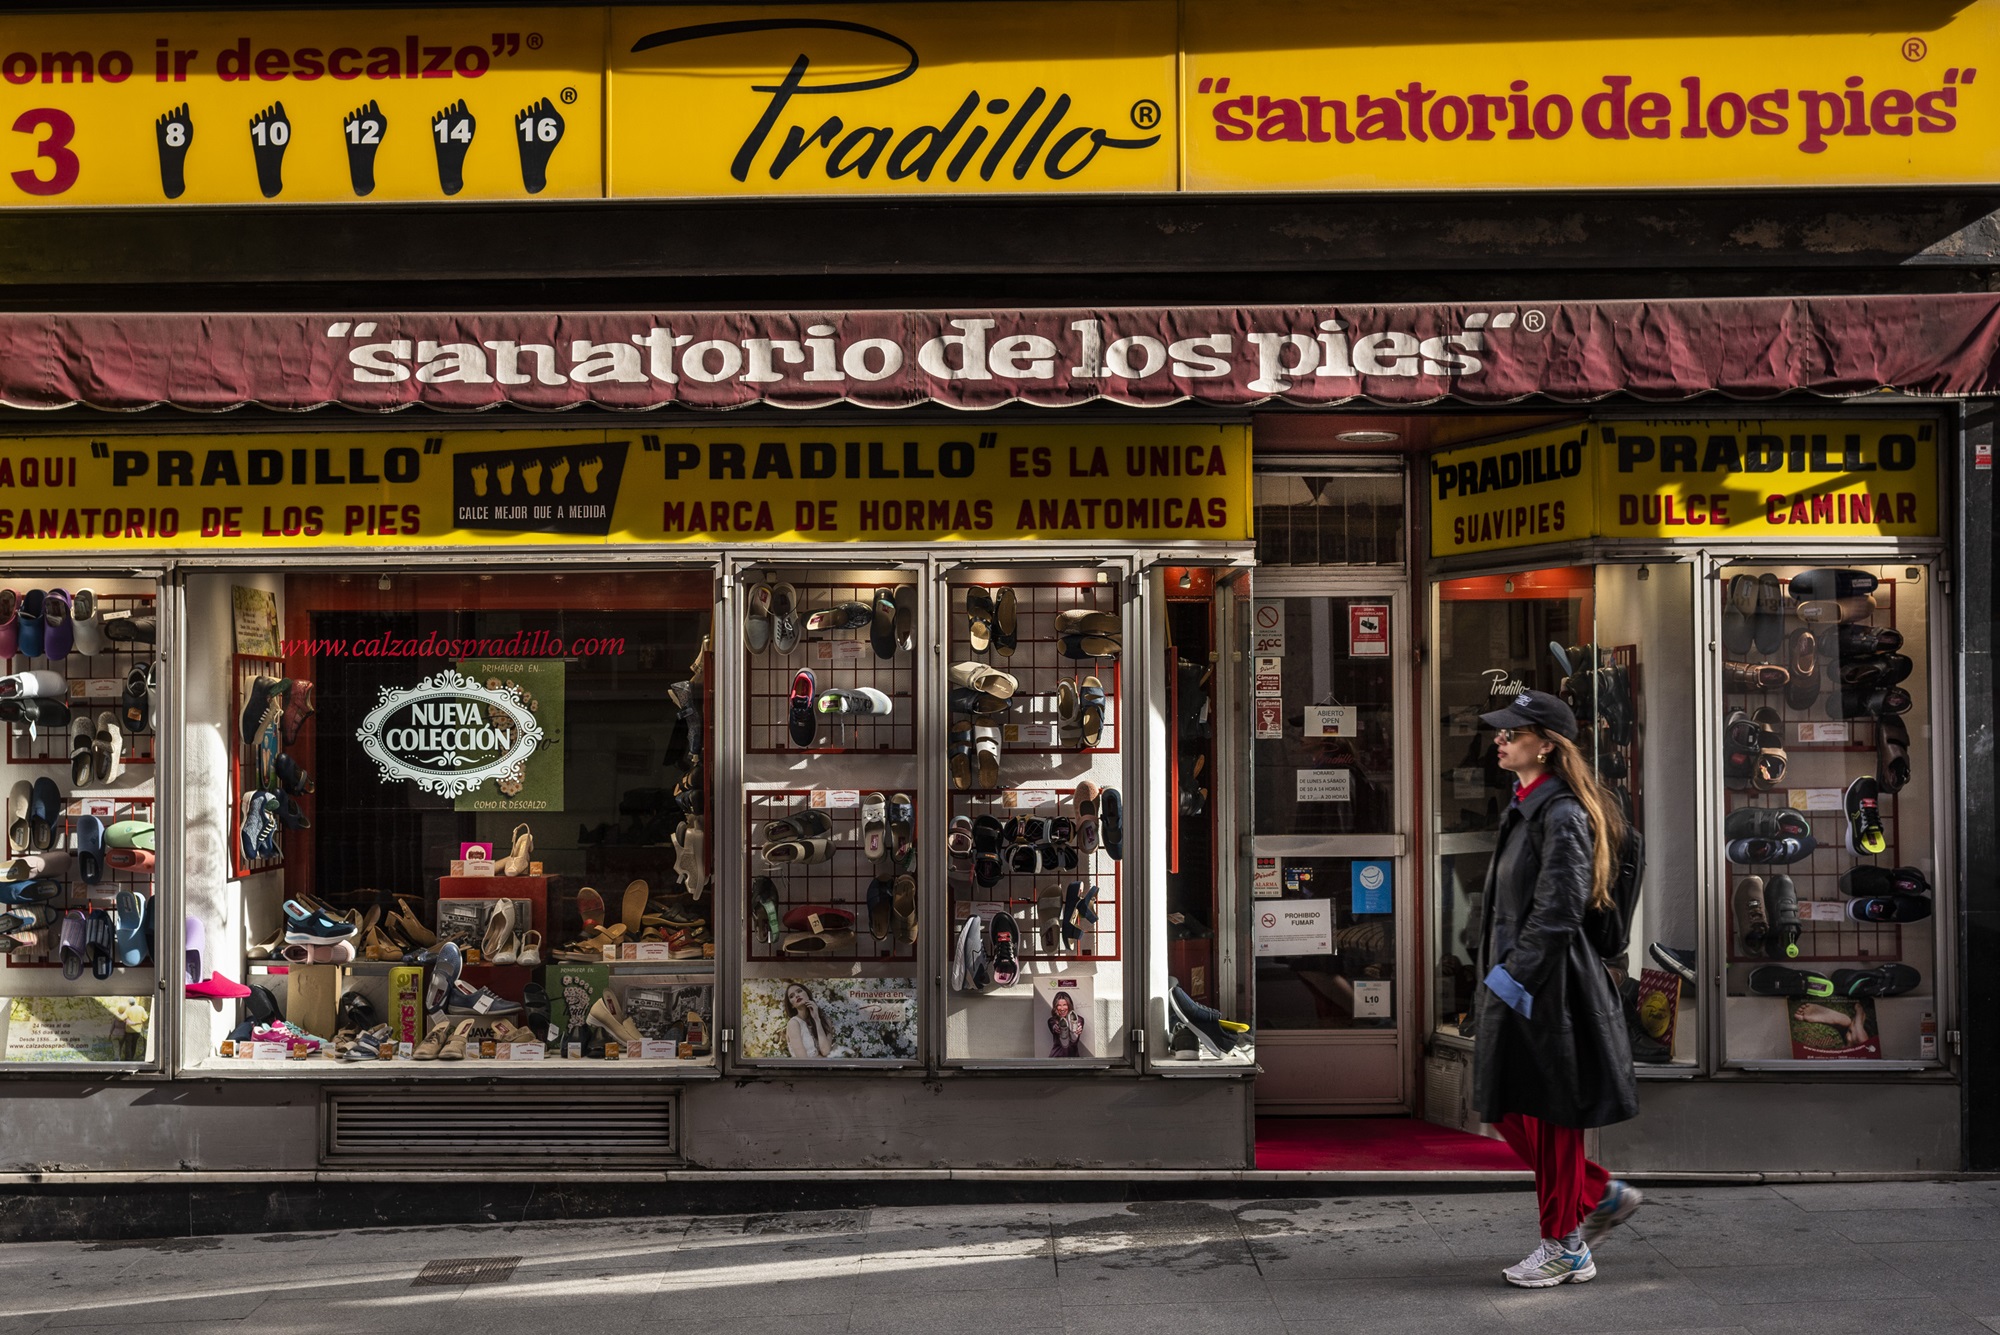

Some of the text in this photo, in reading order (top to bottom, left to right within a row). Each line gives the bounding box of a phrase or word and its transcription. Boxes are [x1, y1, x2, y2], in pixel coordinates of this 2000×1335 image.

[155, 38, 199, 82] ir
[631, 18, 1161, 183] Pradillo
[1581, 75, 1671, 139] de
[1681, 76, 1789, 138] los
[165, 117, 557, 146] 8 10 12 14 16
[10, 107, 80, 196] 3
[918, 318, 1057, 381] de
[1071, 318, 1233, 379] los
[0, 438, 443, 488] AQUI "PRADILLO"
[641, 432, 1226, 480] "PRADILLO" ES LA UNICA
[1601, 425, 1933, 473] "PRADILLO"
[0, 504, 421, 539] SANATORIO DE LOS PIES
[459, 505, 607, 520] CALCE MEJOR QUE A MEDIDA
[663, 497, 1227, 532] MARCA DE HORMAS ANATOMICAS
[1454, 500, 1565, 545] SUAVIPIES
[1619, 492, 1917, 526] DULCE CAMINAR
[279, 631, 625, 662] www.calzadospradillo.com
[482, 664, 524, 674] PRIMAVERA
[1481, 668, 1531, 696] Pradillo
[411, 703, 484, 726] NUEVA
[386, 723, 511, 751] COLECCIÓN
[474, 801, 497, 810] COMO
[508, 801, 547, 810] DESCALZO
[849, 990, 892, 998] Primavera
[1364, 995, 1379, 1003] L10
[859, 1004, 900, 1021] Pradillo
